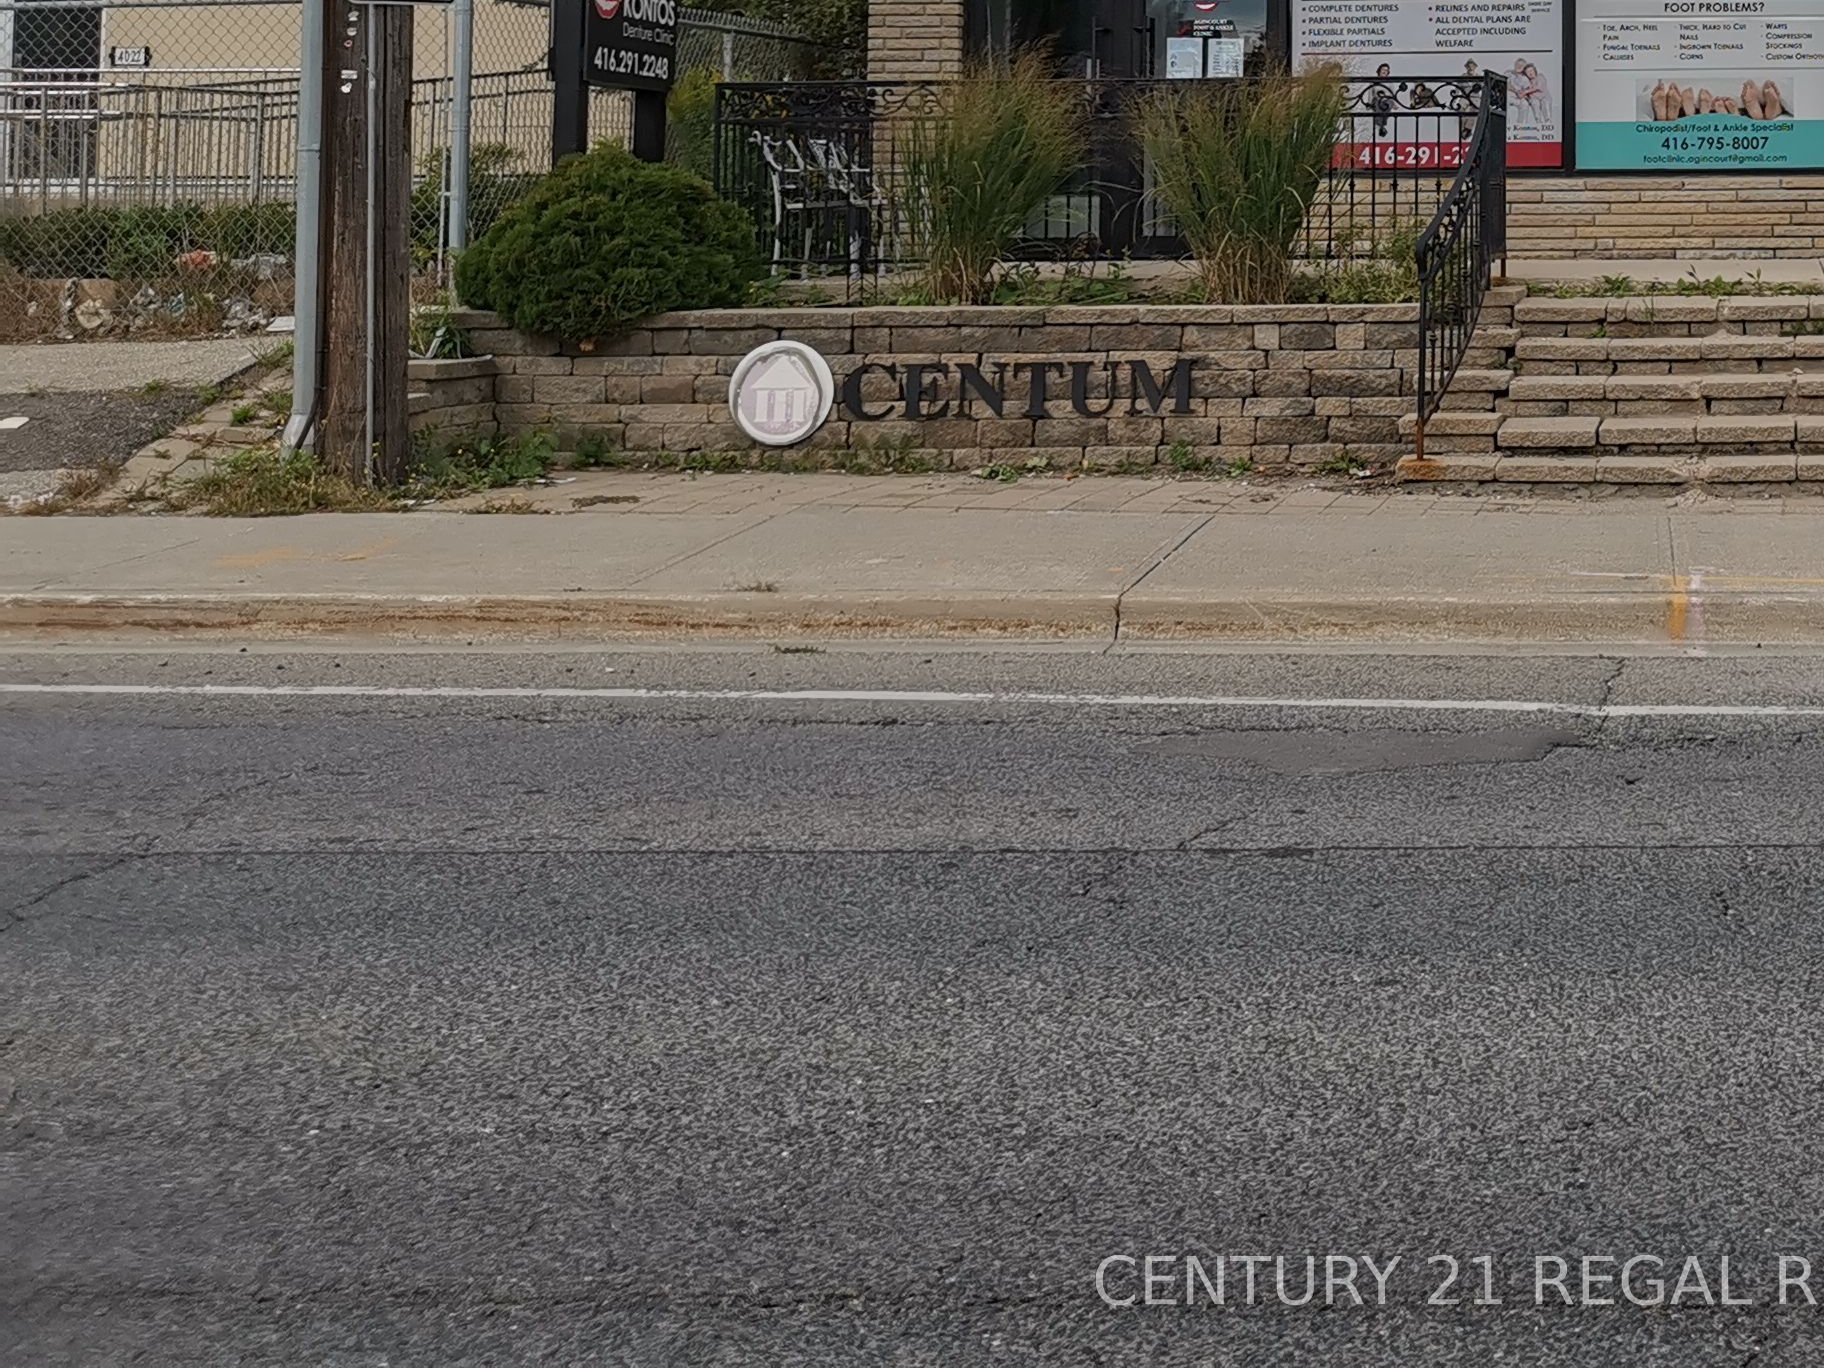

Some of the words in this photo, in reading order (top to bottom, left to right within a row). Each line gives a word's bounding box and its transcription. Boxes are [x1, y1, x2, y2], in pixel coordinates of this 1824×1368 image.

[1308, 4, 1353, 12] COMPLETE
[1355, 4, 1399, 12] DENTURES
[1435, 4, 1469, 12] RELINES
[1471, 4, 1489, 12] AND
[1491, 3, 1526, 12] REPAIRS
[1664, 2, 1696, 13] FOOT
[1699, 2, 1765, 13] PROBLEMS?
[1308, 16, 1342, 24] PARTIAL
[1435, 16, 1450, 24] ALL
[1486, 15, 1513, 23] PLANS
[1514, 15, 1531, 23] ARE
[622, 21, 652, 42] Denture
[654, 28, 675, 47] Clinic
[1308, 28, 1344, 36] FLEXIBLE
[1347, 27, 1385, 35] PARTIALS
[1435, 28, 1478, 36] ACCEPTED
[1480, 27, 1527, 35] INCLUDING
[1308, 40, 1347, 48] IMPLANT
[1349, 39, 1393, 47] DENTURES
[594, 46, 669, 80] 416.291.2248
[1722, 123, 1748, 132] Ankle
[1750, 123, 1794, 133] Specialist
[1661, 136, 1770, 150] 416-795-8007
[843, 358, 1199, 421] CENTUM
